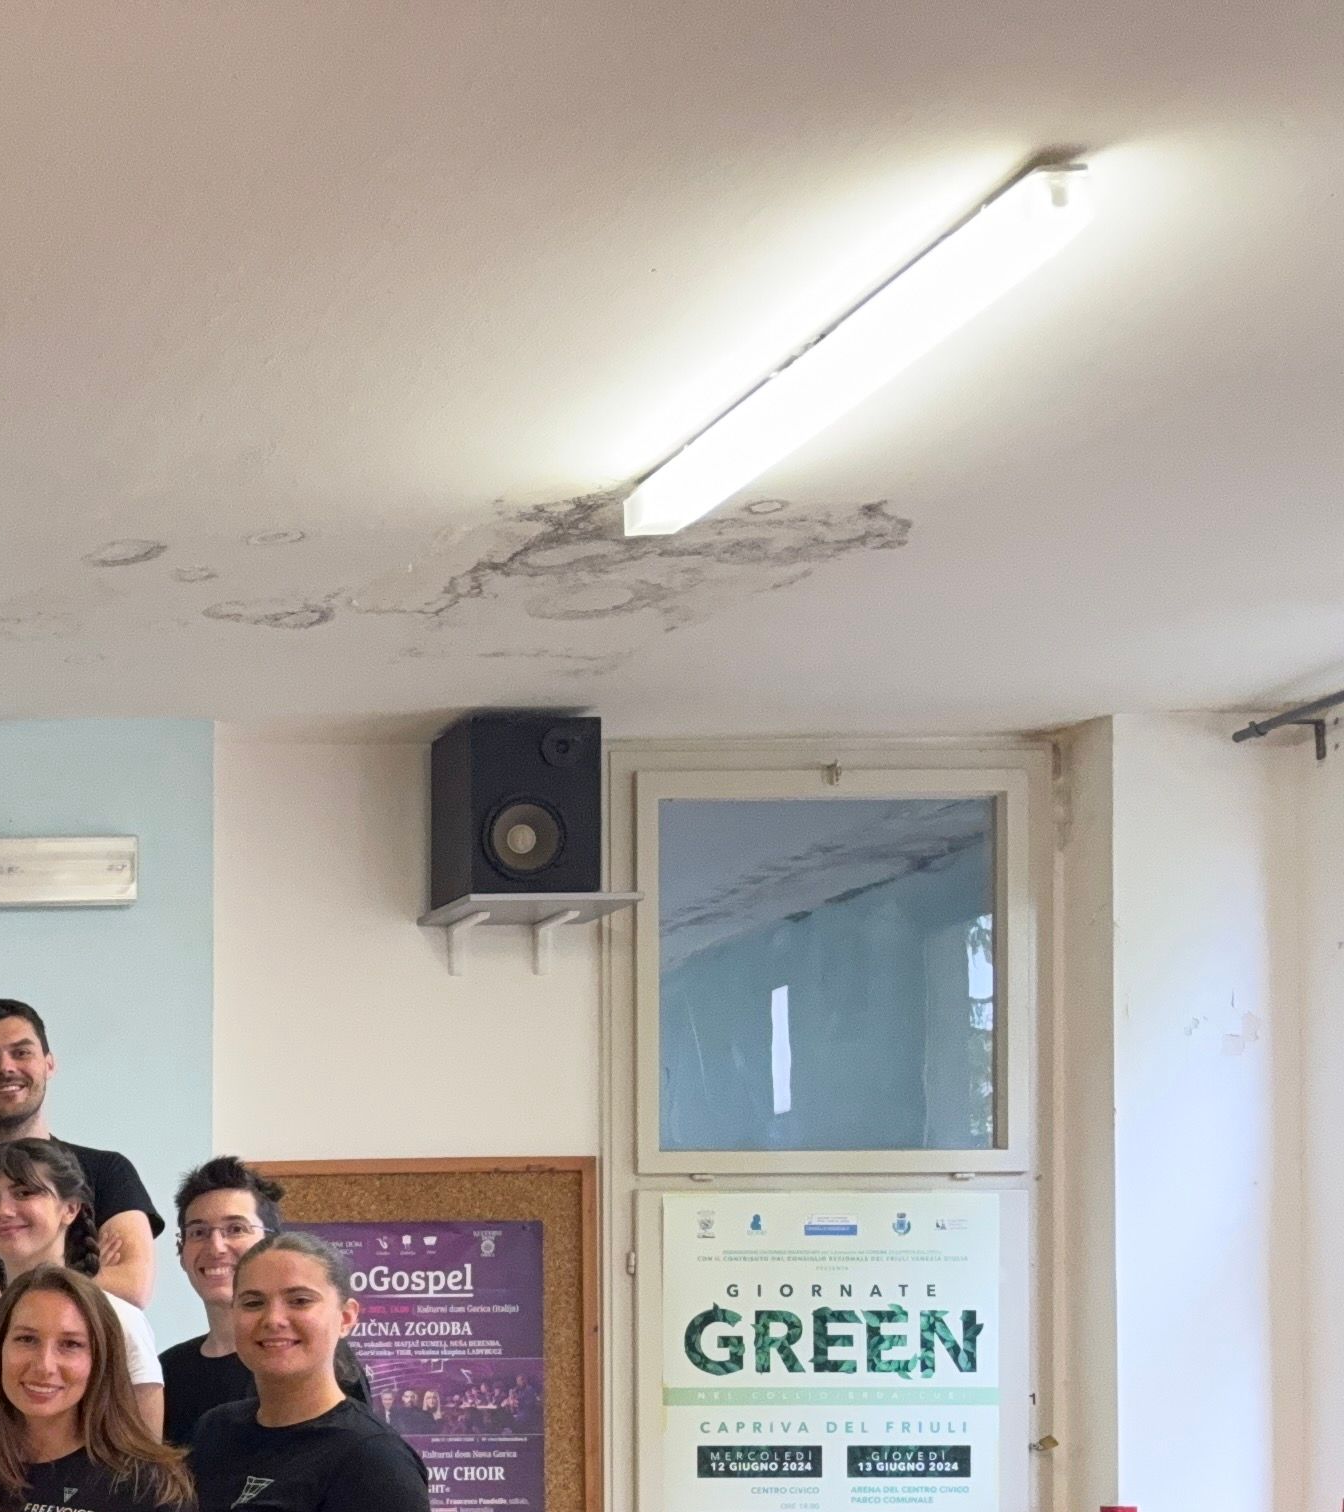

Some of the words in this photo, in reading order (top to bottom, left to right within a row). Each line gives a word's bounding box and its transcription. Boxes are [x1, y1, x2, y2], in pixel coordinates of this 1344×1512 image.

[726, 1284, 937, 1298] GIORNATE
[404, 1321, 473, 1337] ZGODBA
[683, 1307, 980, 1376] GREEN
[700, 1421, 810, 1434] CAPRIVA
[826, 1421, 869, 1434] DEL
[885, 1421, 968, 1434] FRIULI
[453, 1466, 506, 1480] CHOIR
[710, 1462, 727, 1472] 12
[729, 1462, 779, 1472] GIUGNO
[782, 1462, 813, 1472] 2024
[858, 1462, 874, 1472] 13
[876, 1462, 926, 1472] GIUGNO
[928, 1462, 960, 1472] 2024
[750, 1486, 787, 1495] CENTRO
[789, 1486, 820, 1495] CIVICO
[850, 1496, 881, 1504] PARCO
[883, 1496, 933, 1504] COMUNALE
